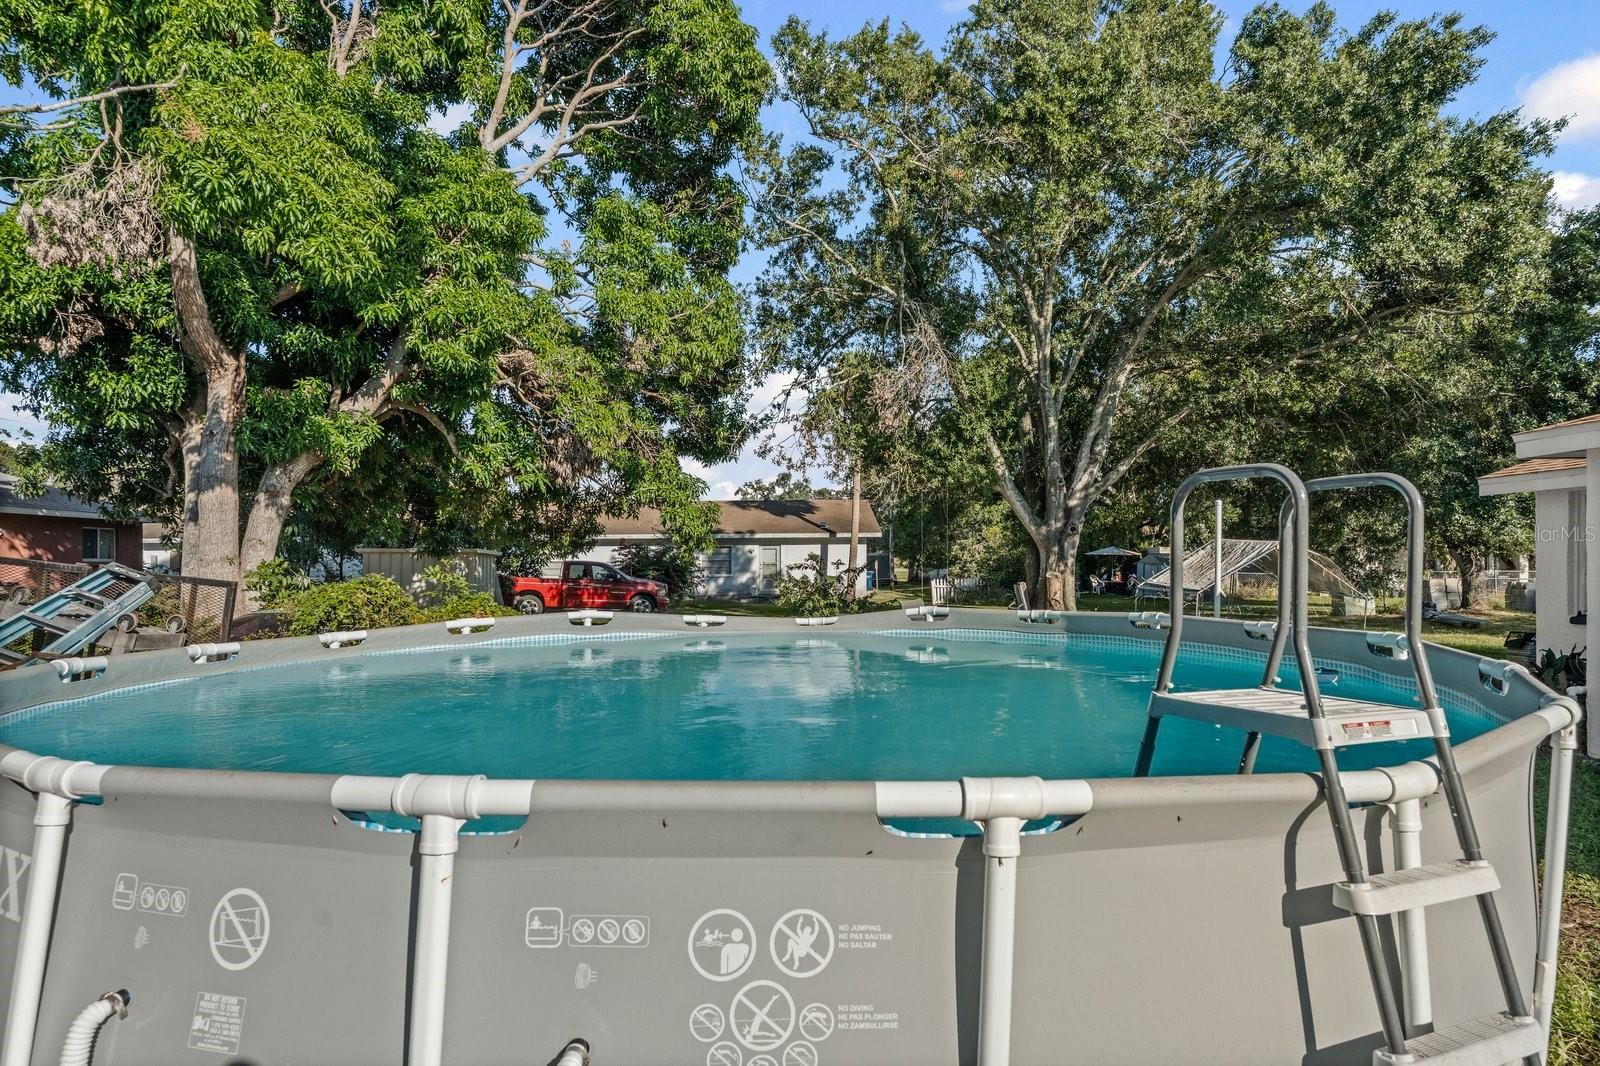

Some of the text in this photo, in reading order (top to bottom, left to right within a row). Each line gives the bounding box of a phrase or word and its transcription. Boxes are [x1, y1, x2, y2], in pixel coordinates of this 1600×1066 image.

[839, 924, 881, 932] NO JUMPING
[838, 941, 877, 949] NO SALTAR
[838, 1004, 874, 1012] NO DIVING
[864, 1013, 898, 1021] PLONGER
